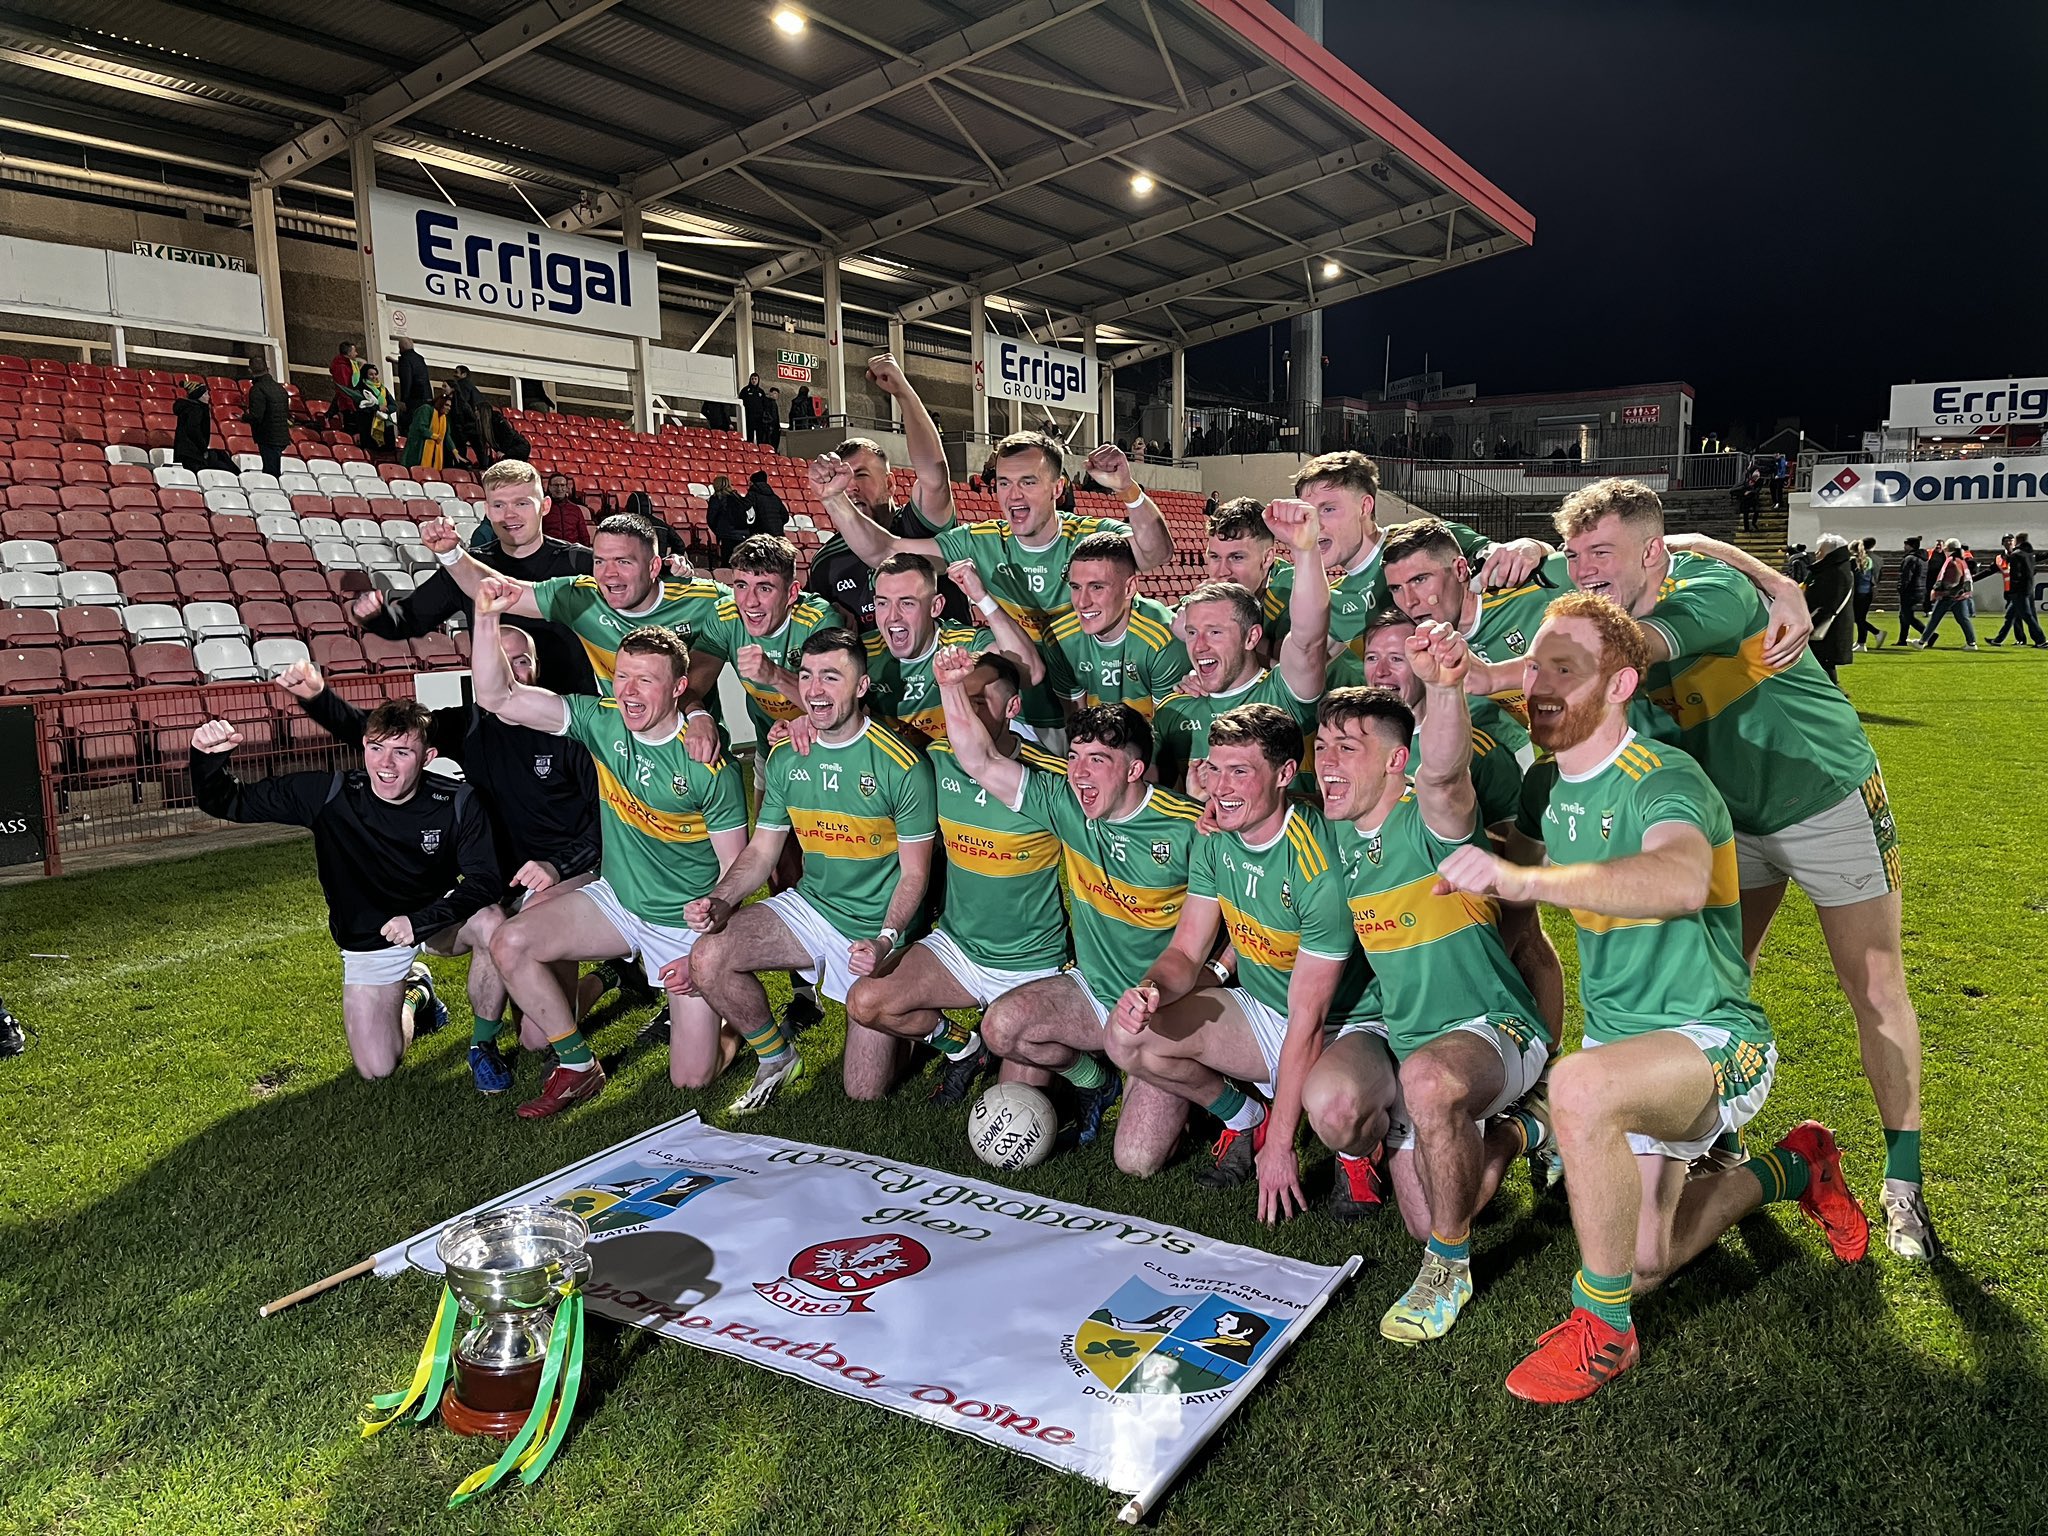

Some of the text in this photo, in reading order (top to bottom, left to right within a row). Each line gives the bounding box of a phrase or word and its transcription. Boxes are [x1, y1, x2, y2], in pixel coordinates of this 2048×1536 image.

[171, 248, 211, 266] EXIT
[415, 209, 632, 315] Errigal
[425, 273, 546, 312] GROUP
[830, 330, 838, 346] J
[781, 351, 800, 364] EXIT
[974, 360, 984, 374] K
[779, 367, 806, 379] TOILETS
[1001, 342, 1086, 402] Errigal
[1003, 381, 1051, 401] GROUP
[1624, 416, 1657, 424] TOILETS
[1935, 412, 2018, 425] GROUP
[1027, 574, 1045, 593] 19
[1361, 590, 1377, 613] 10
[1101, 668, 1121, 687] 20
[903, 682, 926, 701] 23
[635, 763, 651, 787] 12
[822, 771, 840, 792] 14
[974, 788, 987, 807] 4
[816, 820, 849, 832] KELLYS
[1568, 815, 1577, 842] 8
[945, 839, 1013, 860] UROSPAR
[957, 833, 995, 849] KELLYS
[1110, 841, 1126, 862] 15
[1245, 873, 1258, 899] 11
[976, 1107, 1013, 1153] SENIORS
[593, 1223, 650, 1241] RATHA
[1170, 1281, 1254, 1301] AN GLEANN
[1185, 1276, 1237, 1288] WATTY
[1239, 1284, 1308, 1311] GRAHAM
[1060, 1333, 1091, 1379] MACHAIRE
